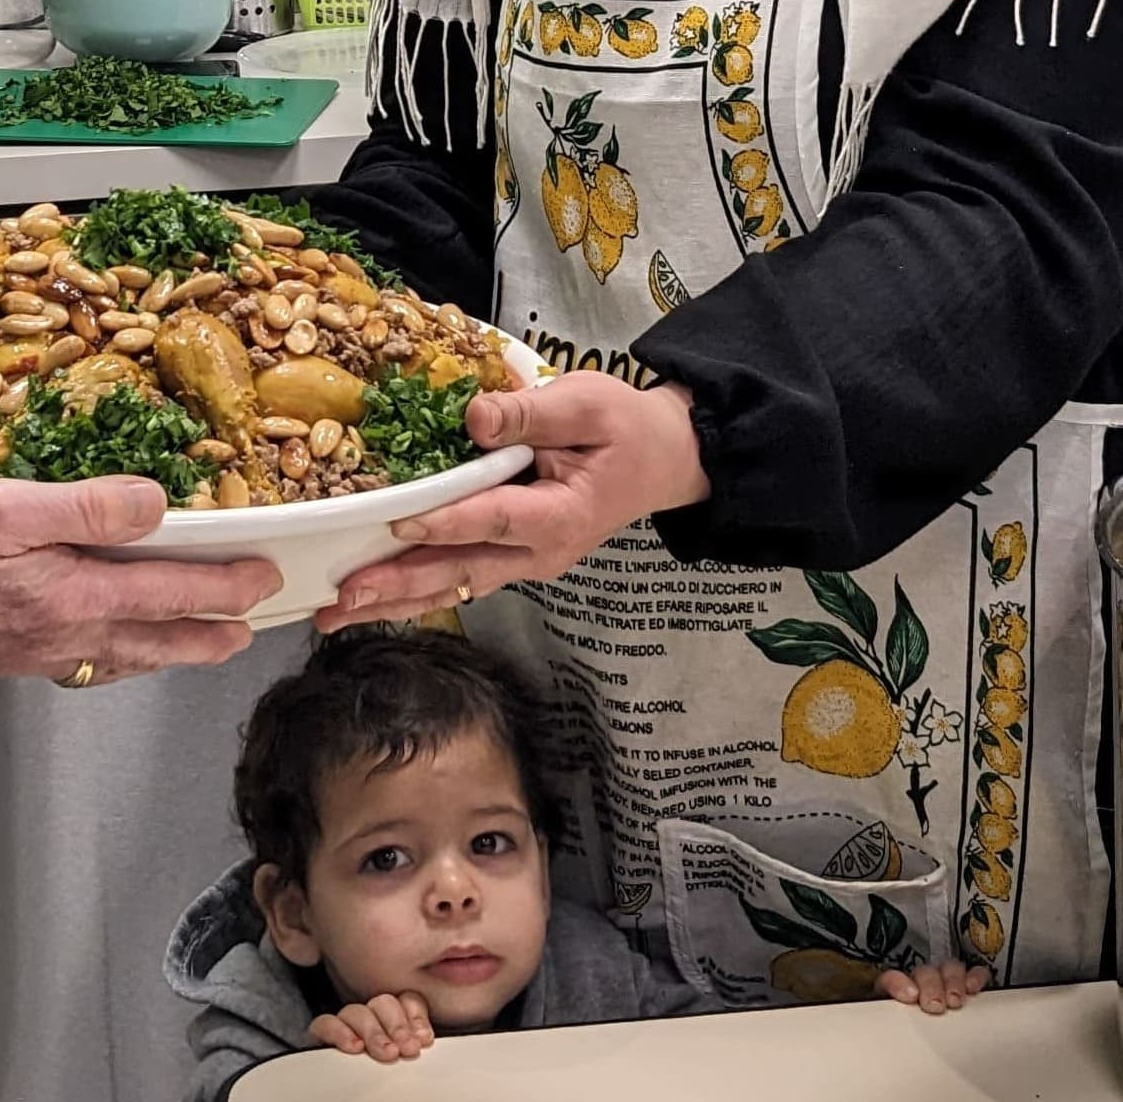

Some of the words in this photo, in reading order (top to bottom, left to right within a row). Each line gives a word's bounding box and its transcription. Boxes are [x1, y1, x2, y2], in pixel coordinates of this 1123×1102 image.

[590, 557, 622, 573] UNITE
[625, 559, 677, 574] L'INFUSO
[603, 580, 628, 594] CON
[631, 582, 648, 595] UN
[651, 581, 686, 594] CHILO
[689, 581, 699, 594] DI
[702, 581, 767, 595] ZUCCHERO
[770, 581, 782, 593] IN
[586, 594, 653, 614] MESCOLATE
[695, 601, 754, 615] RIPOSARE
[757, 601, 768, 613] IL
[595, 613, 646, 631] FILTRATE
[649, 618, 665, 630] ED
[578, 635, 612, 654] MOLTO
[615, 643, 667, 657] FREDDO.
[633, 700, 686, 714] ALCOHOL
[631, 749, 641, 760] IT
[644, 750, 660, 762] TO
[663, 748, 705, 762] INFUSE
[709, 746, 721, 757] IN
[723, 740, 779, 755] ALCOHOL
[643, 768, 681, 782] SELED
[718, 775, 748, 788] WITH
[754, 776, 777, 789] THE
[689, 794, 726, 810] USING
[744, 794, 772, 808] KILO
